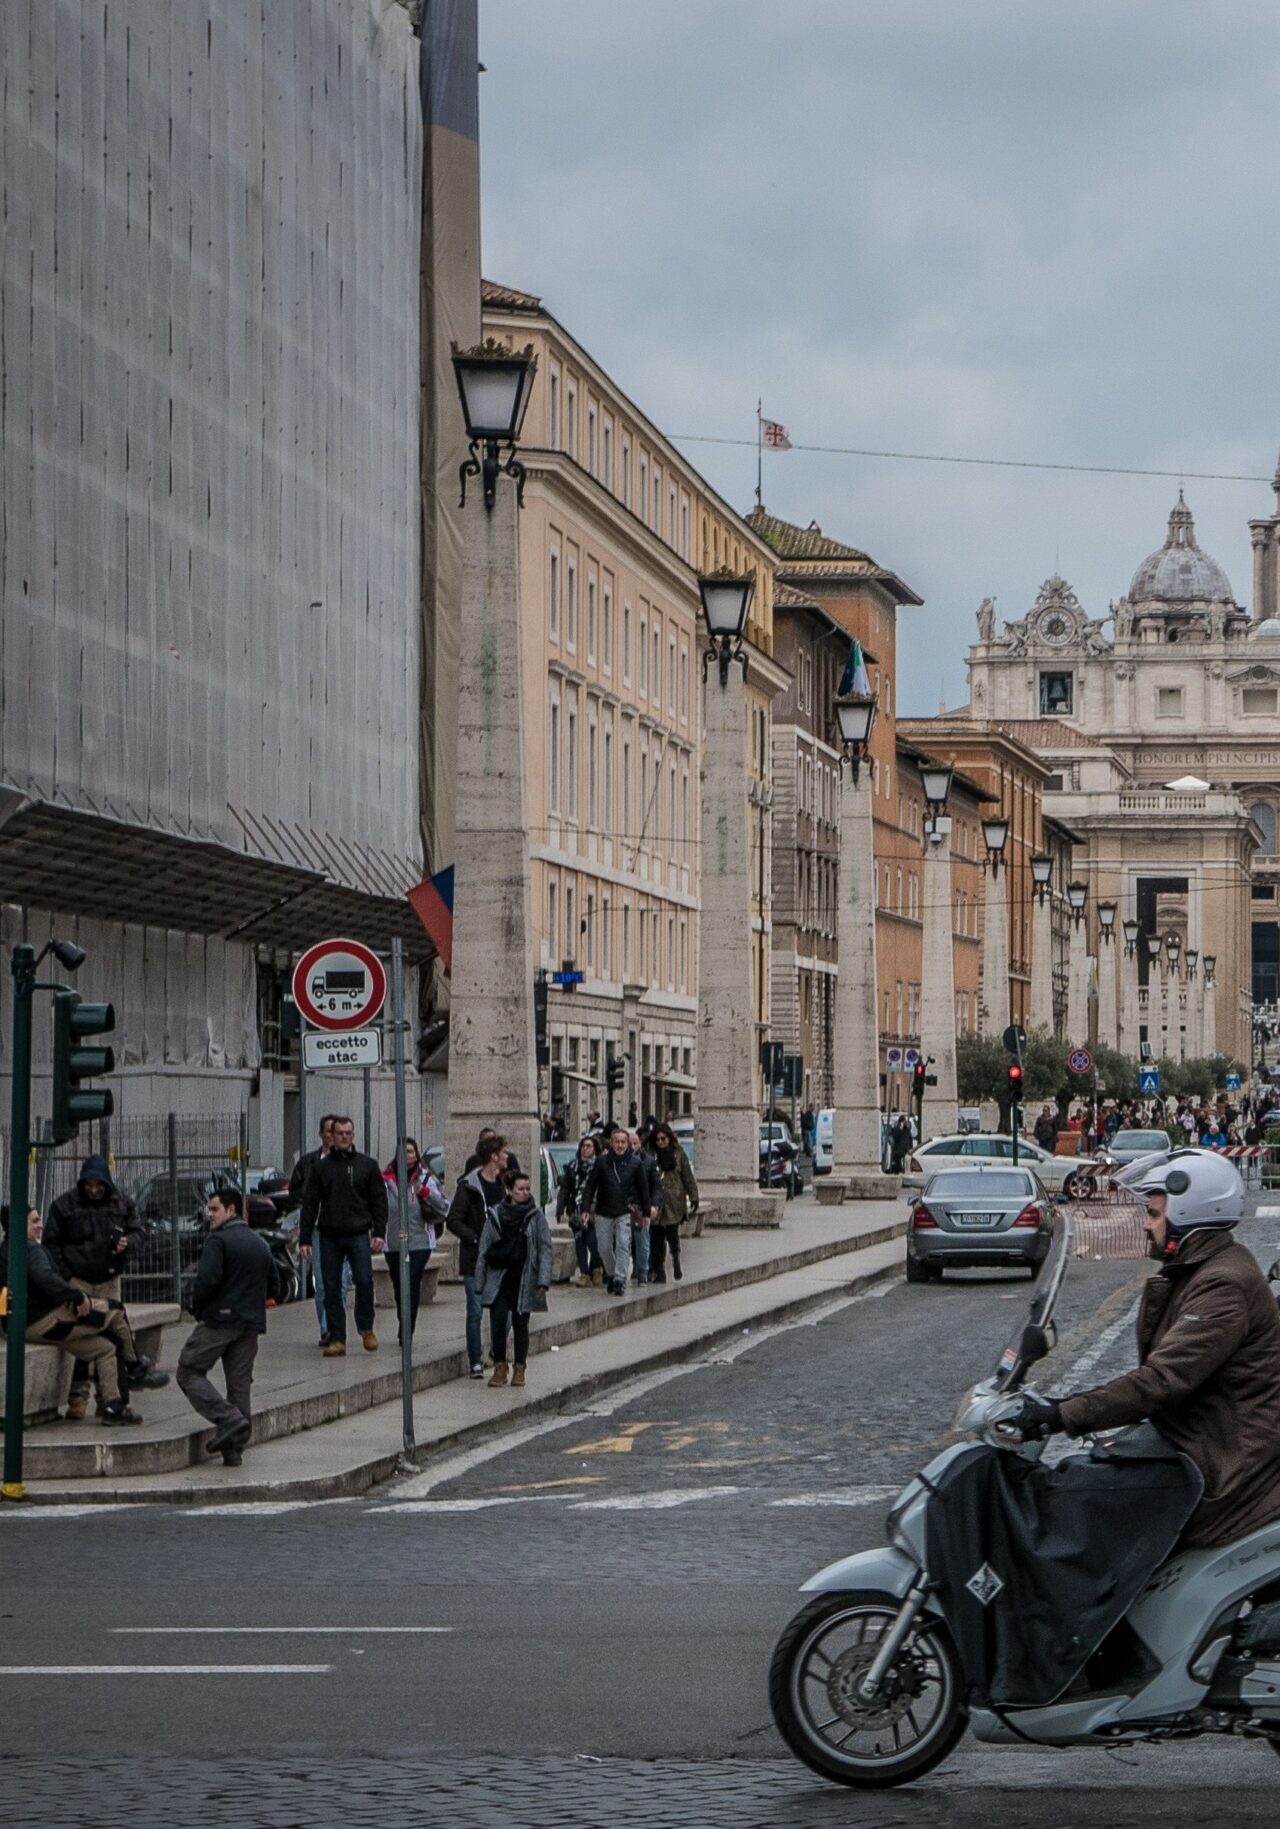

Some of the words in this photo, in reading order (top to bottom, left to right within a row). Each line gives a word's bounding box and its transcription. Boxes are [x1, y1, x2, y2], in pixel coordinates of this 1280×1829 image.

[1134, 753, 1205, 764] HONOREM
[1208, 752, 1278, 764] PRINCIPIS
[328, 997, 336, 1011] 6
[342, 1000, 352, 1011] m
[316, 1036, 368, 1049] eccetto
[328, 1051, 358, 1063] atac
